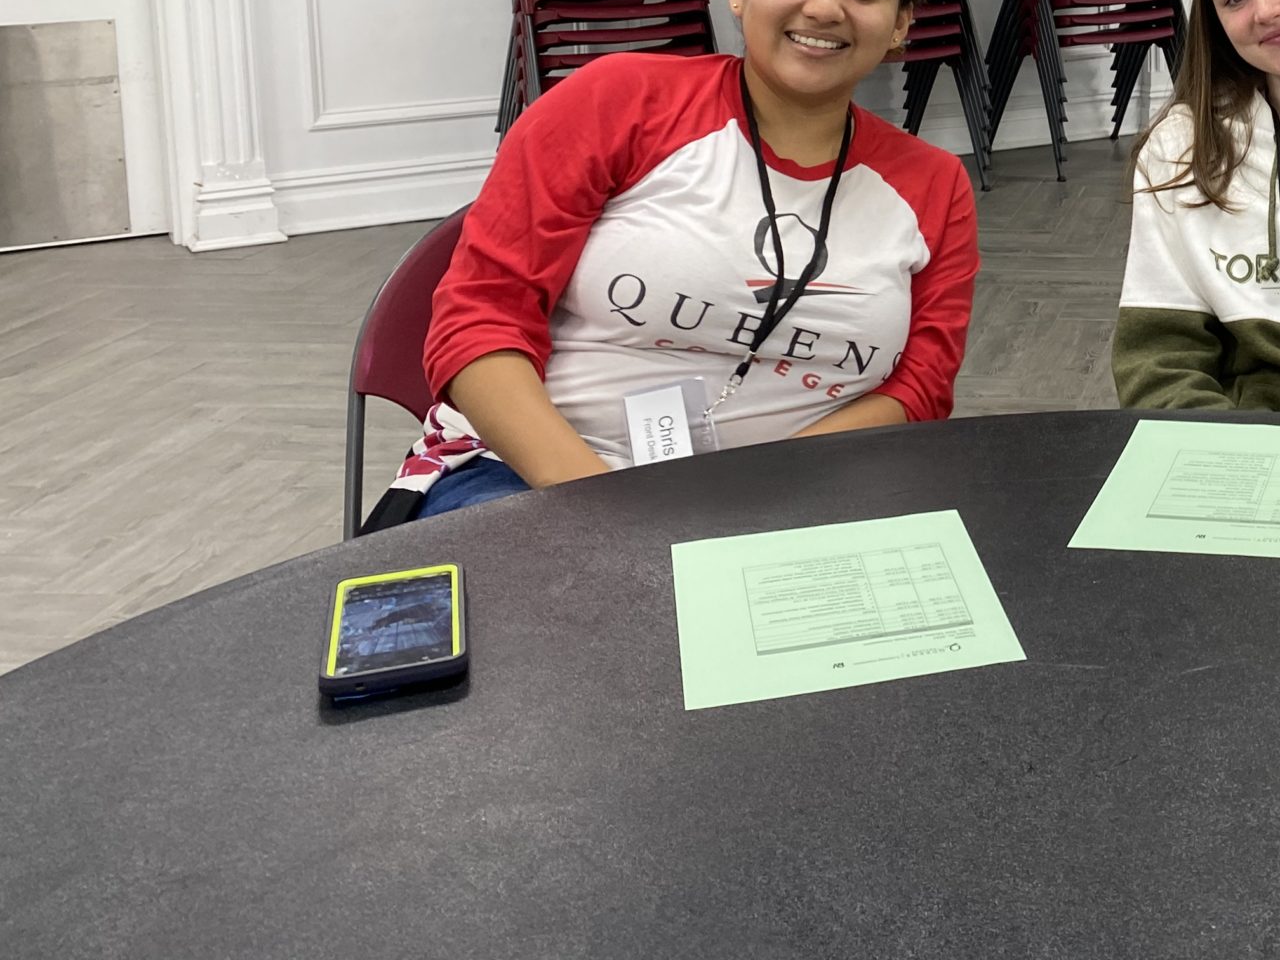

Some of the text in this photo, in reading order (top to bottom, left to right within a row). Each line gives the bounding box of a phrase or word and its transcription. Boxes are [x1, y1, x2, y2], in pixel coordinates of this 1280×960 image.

[607, 272, 903, 381] QUEEN
[654, 338, 846, 399] CEGE
[643, 417, 657, 461] Front Desk
[657, 415, 678, 456] Chris
